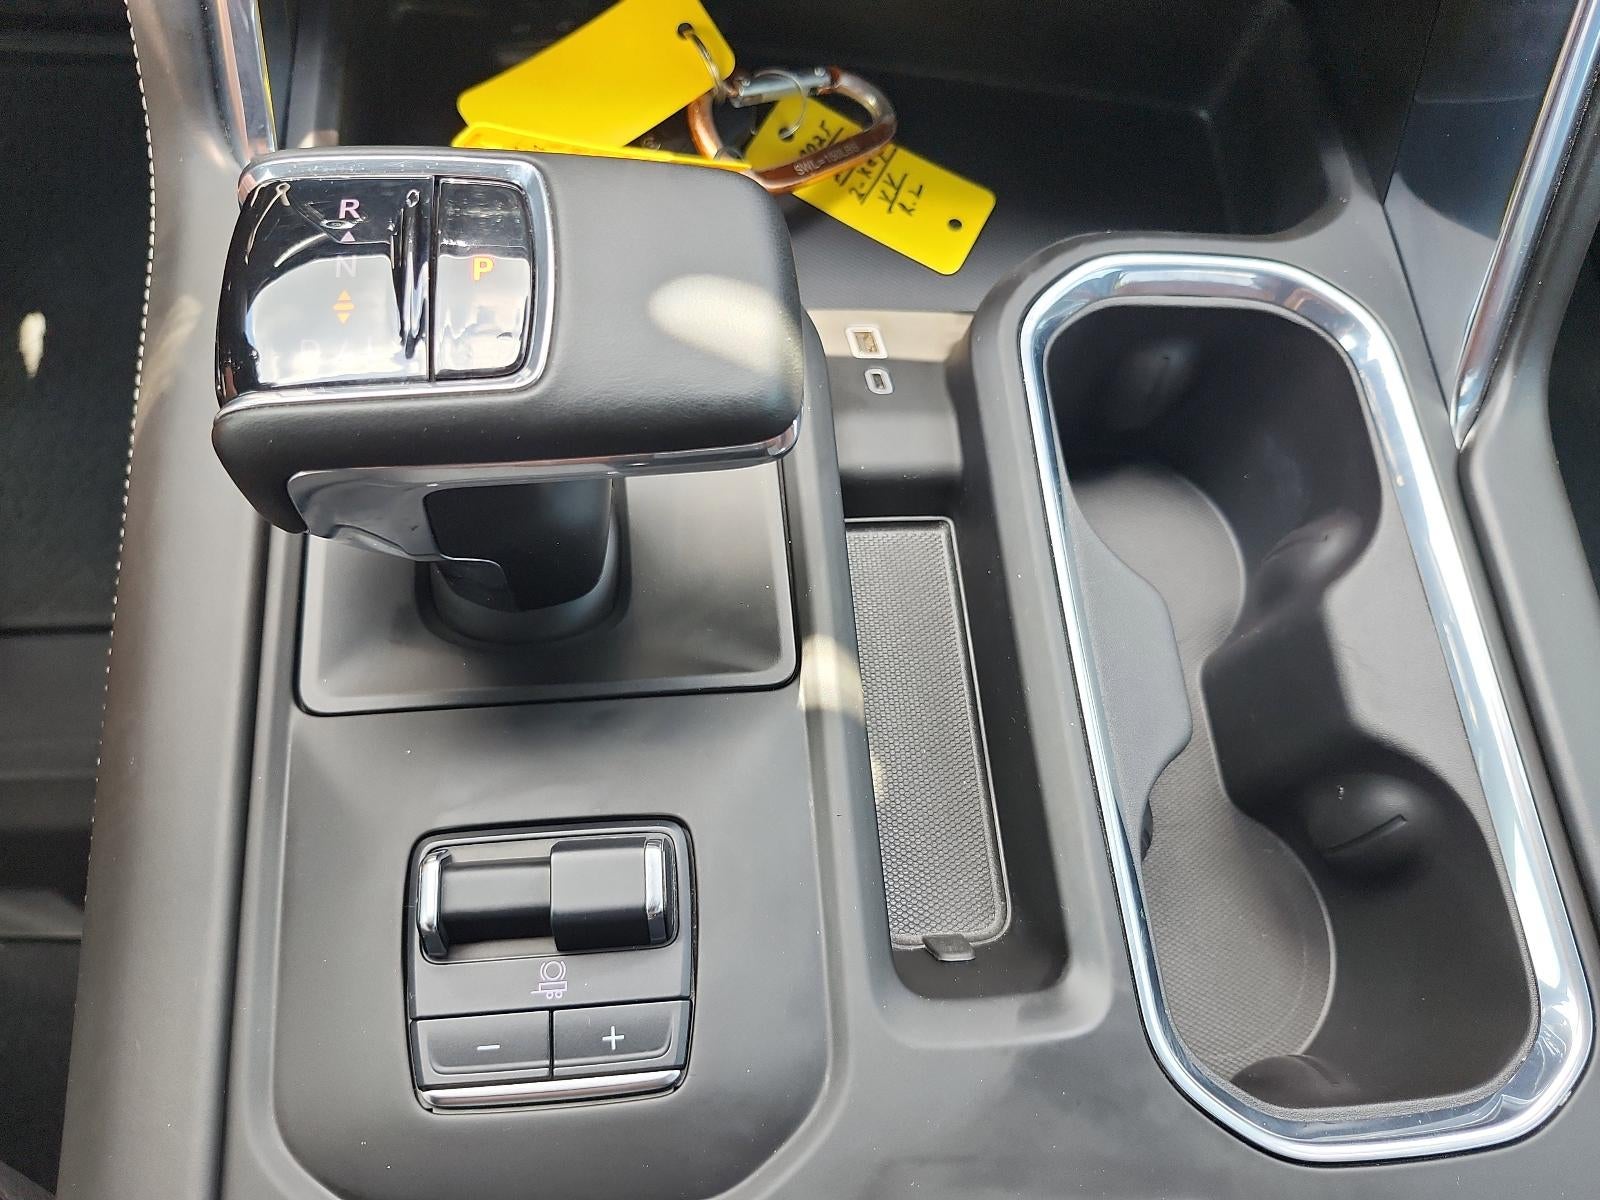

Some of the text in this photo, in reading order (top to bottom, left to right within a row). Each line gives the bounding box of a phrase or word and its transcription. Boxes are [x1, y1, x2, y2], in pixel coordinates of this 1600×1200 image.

[338, 199, 361, 219] R
[335, 256, 357, 278] N
[472, 256, 494, 281] P
